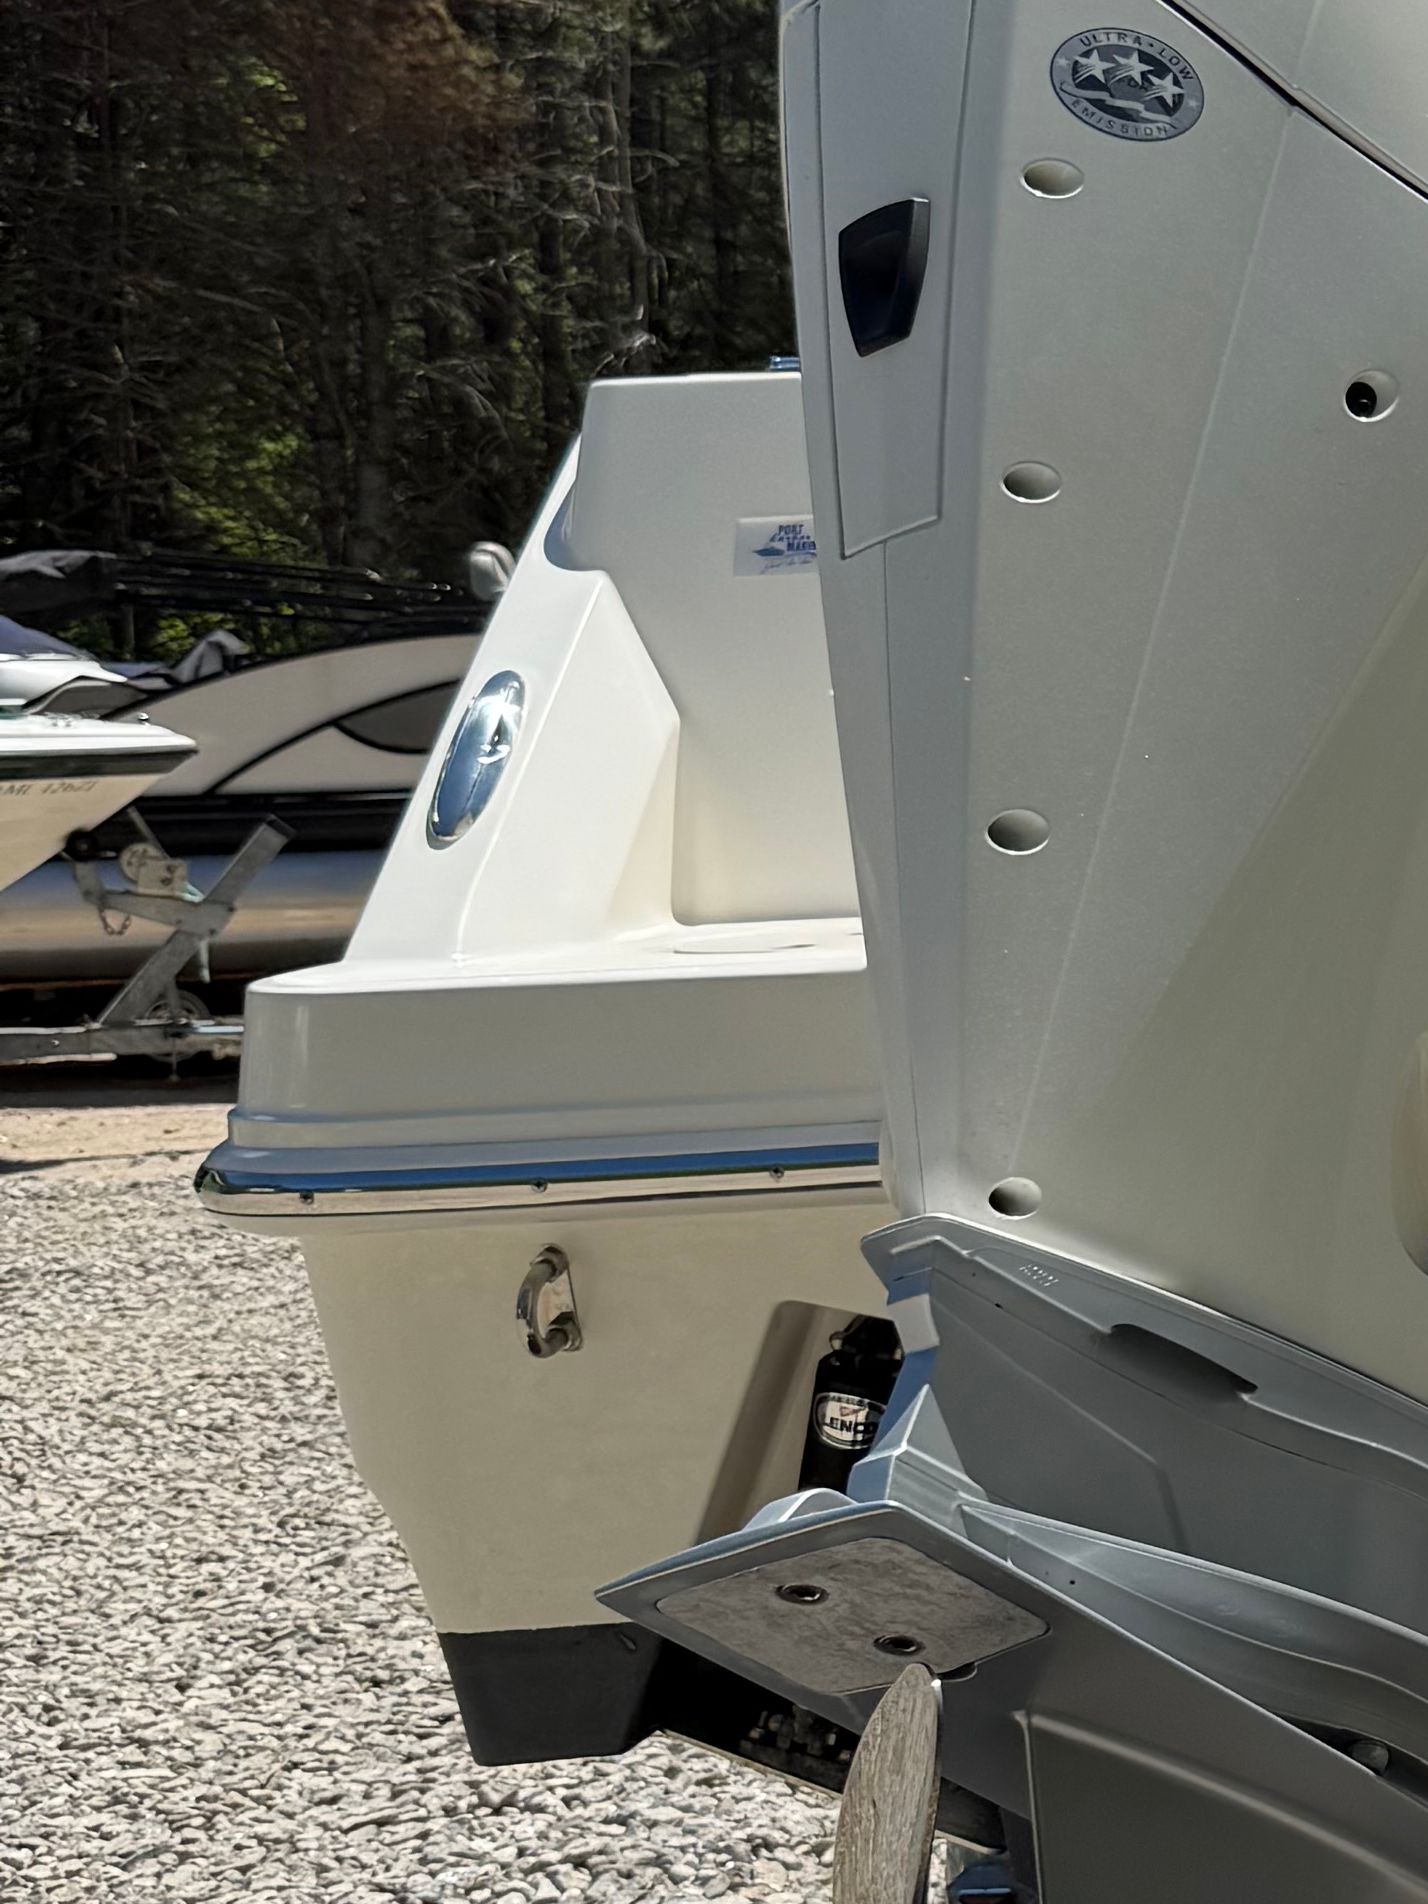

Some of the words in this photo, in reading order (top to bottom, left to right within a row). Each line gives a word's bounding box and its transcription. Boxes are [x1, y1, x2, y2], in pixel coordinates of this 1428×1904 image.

[1079, 31, 1143, 47] ULTRA
[1157, 47, 1194, 81] LOW
[1071, 99, 1168, 137] EMISSION
